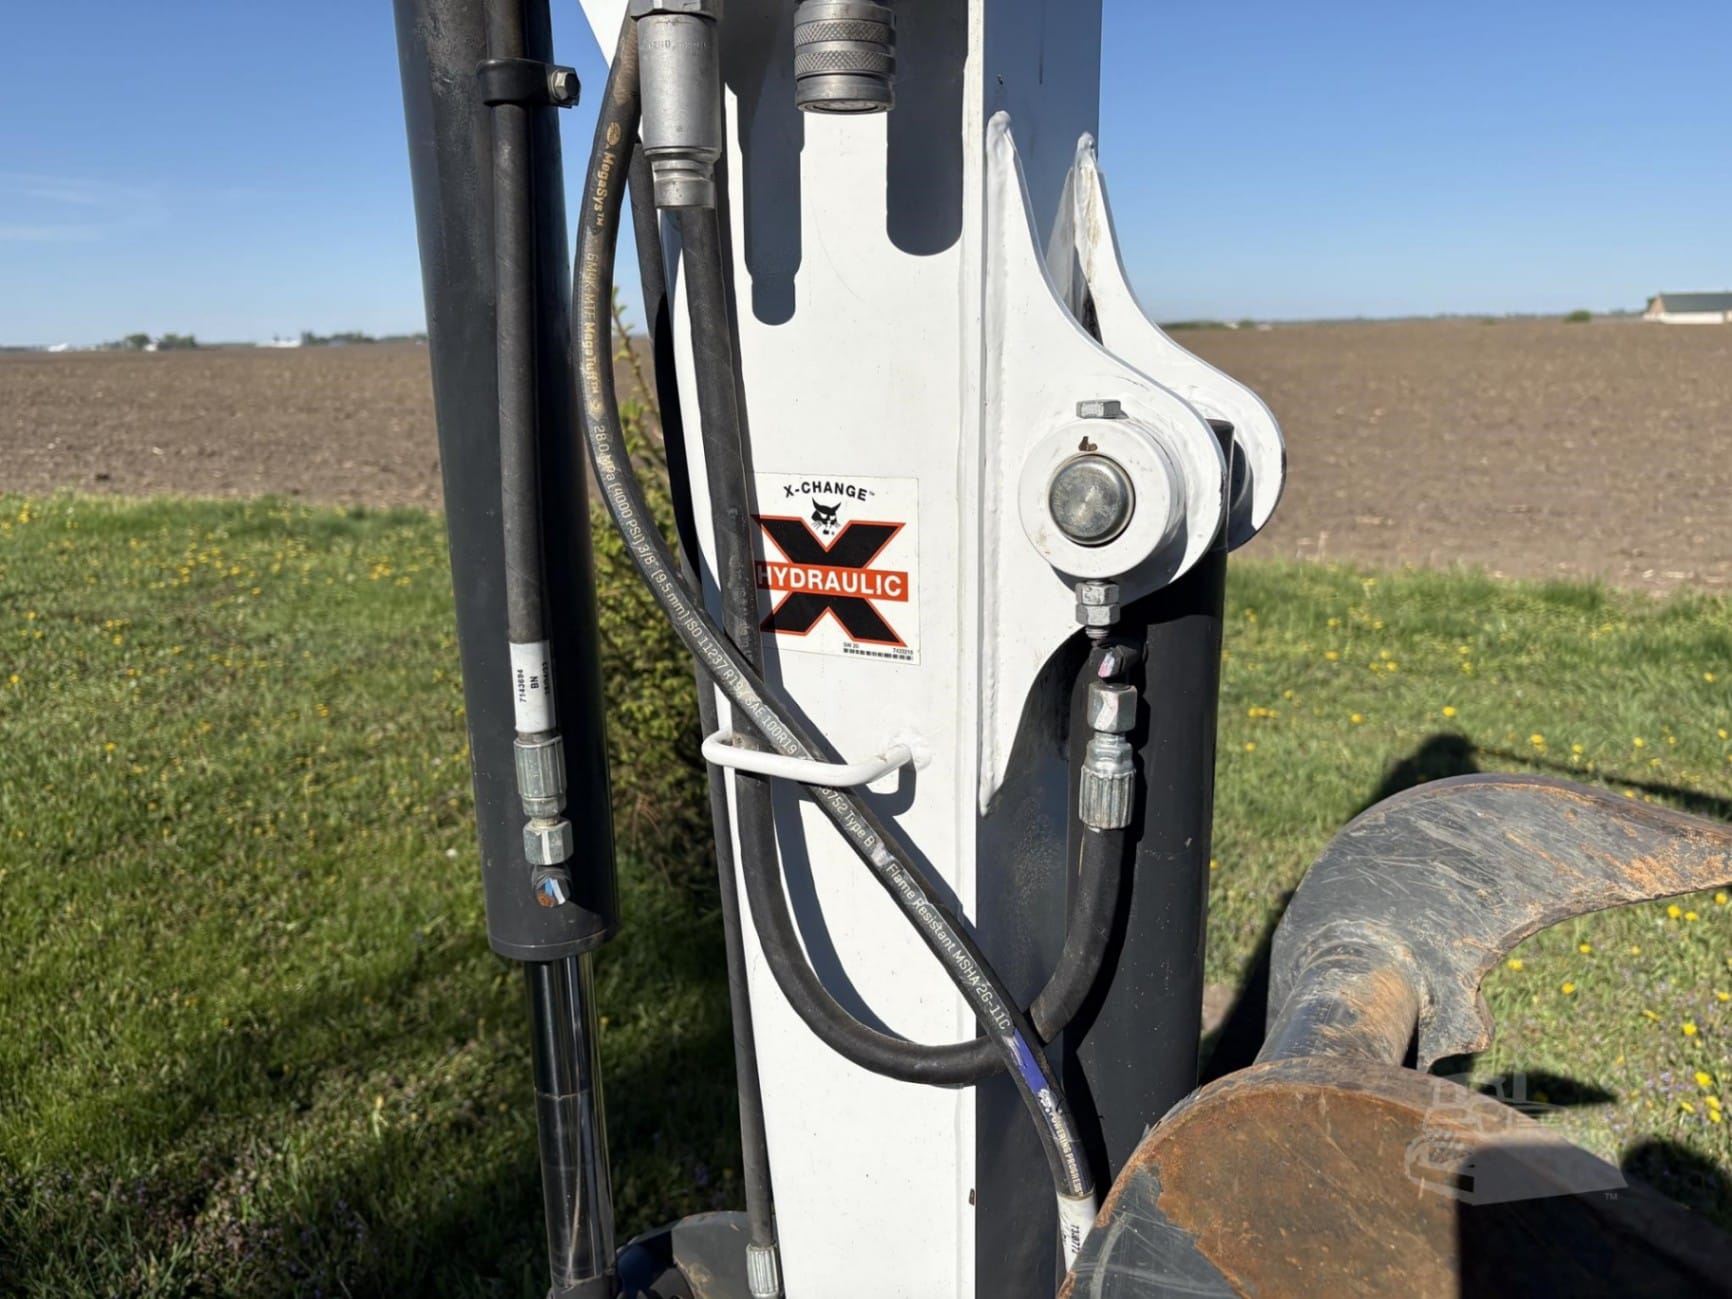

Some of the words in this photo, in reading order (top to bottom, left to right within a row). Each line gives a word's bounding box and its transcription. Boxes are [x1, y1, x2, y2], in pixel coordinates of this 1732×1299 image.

[757, 563, 902, 597] HYDRAULIC
[530, 675, 540, 689] BN
[684, 616, 703, 637] ISO
[696, 634, 728, 671] 11237
[744, 694, 766, 717] SAE
[760, 713, 798, 756] 100R19
[841, 809, 869, 839] Type
[885, 862, 918, 899] Flame
[911, 896, 957, 952] Resistant
[951, 948, 981, 986] MSHA
